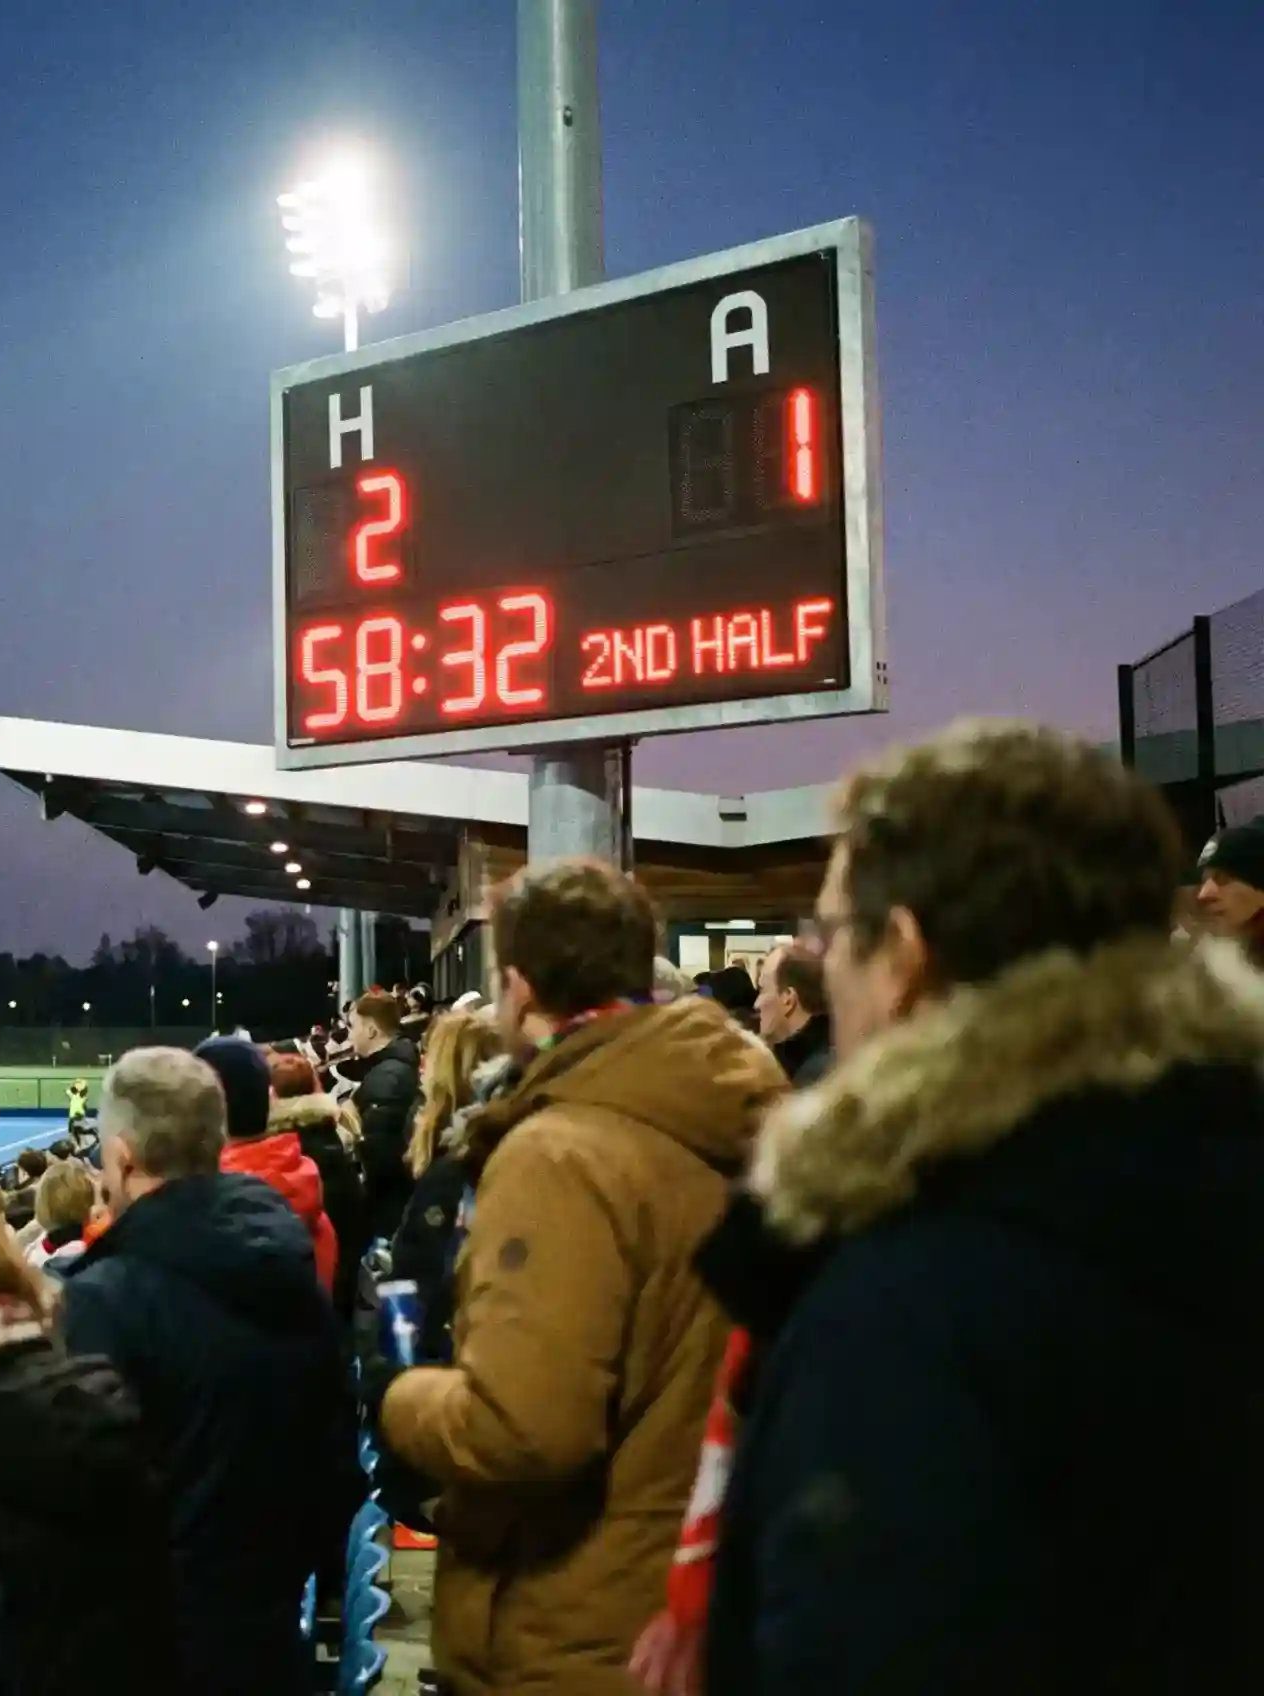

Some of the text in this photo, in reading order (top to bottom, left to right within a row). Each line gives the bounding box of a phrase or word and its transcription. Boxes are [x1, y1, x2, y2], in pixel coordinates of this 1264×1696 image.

[710, 290, 770, 384] A
[328, 385, 375, 469] H
[792, 386, 815, 500] 1
[354, 474, 402, 582] 2
[300, 592, 548, 730] 58:32
[580, 597, 832, 688] 2ND HALF
